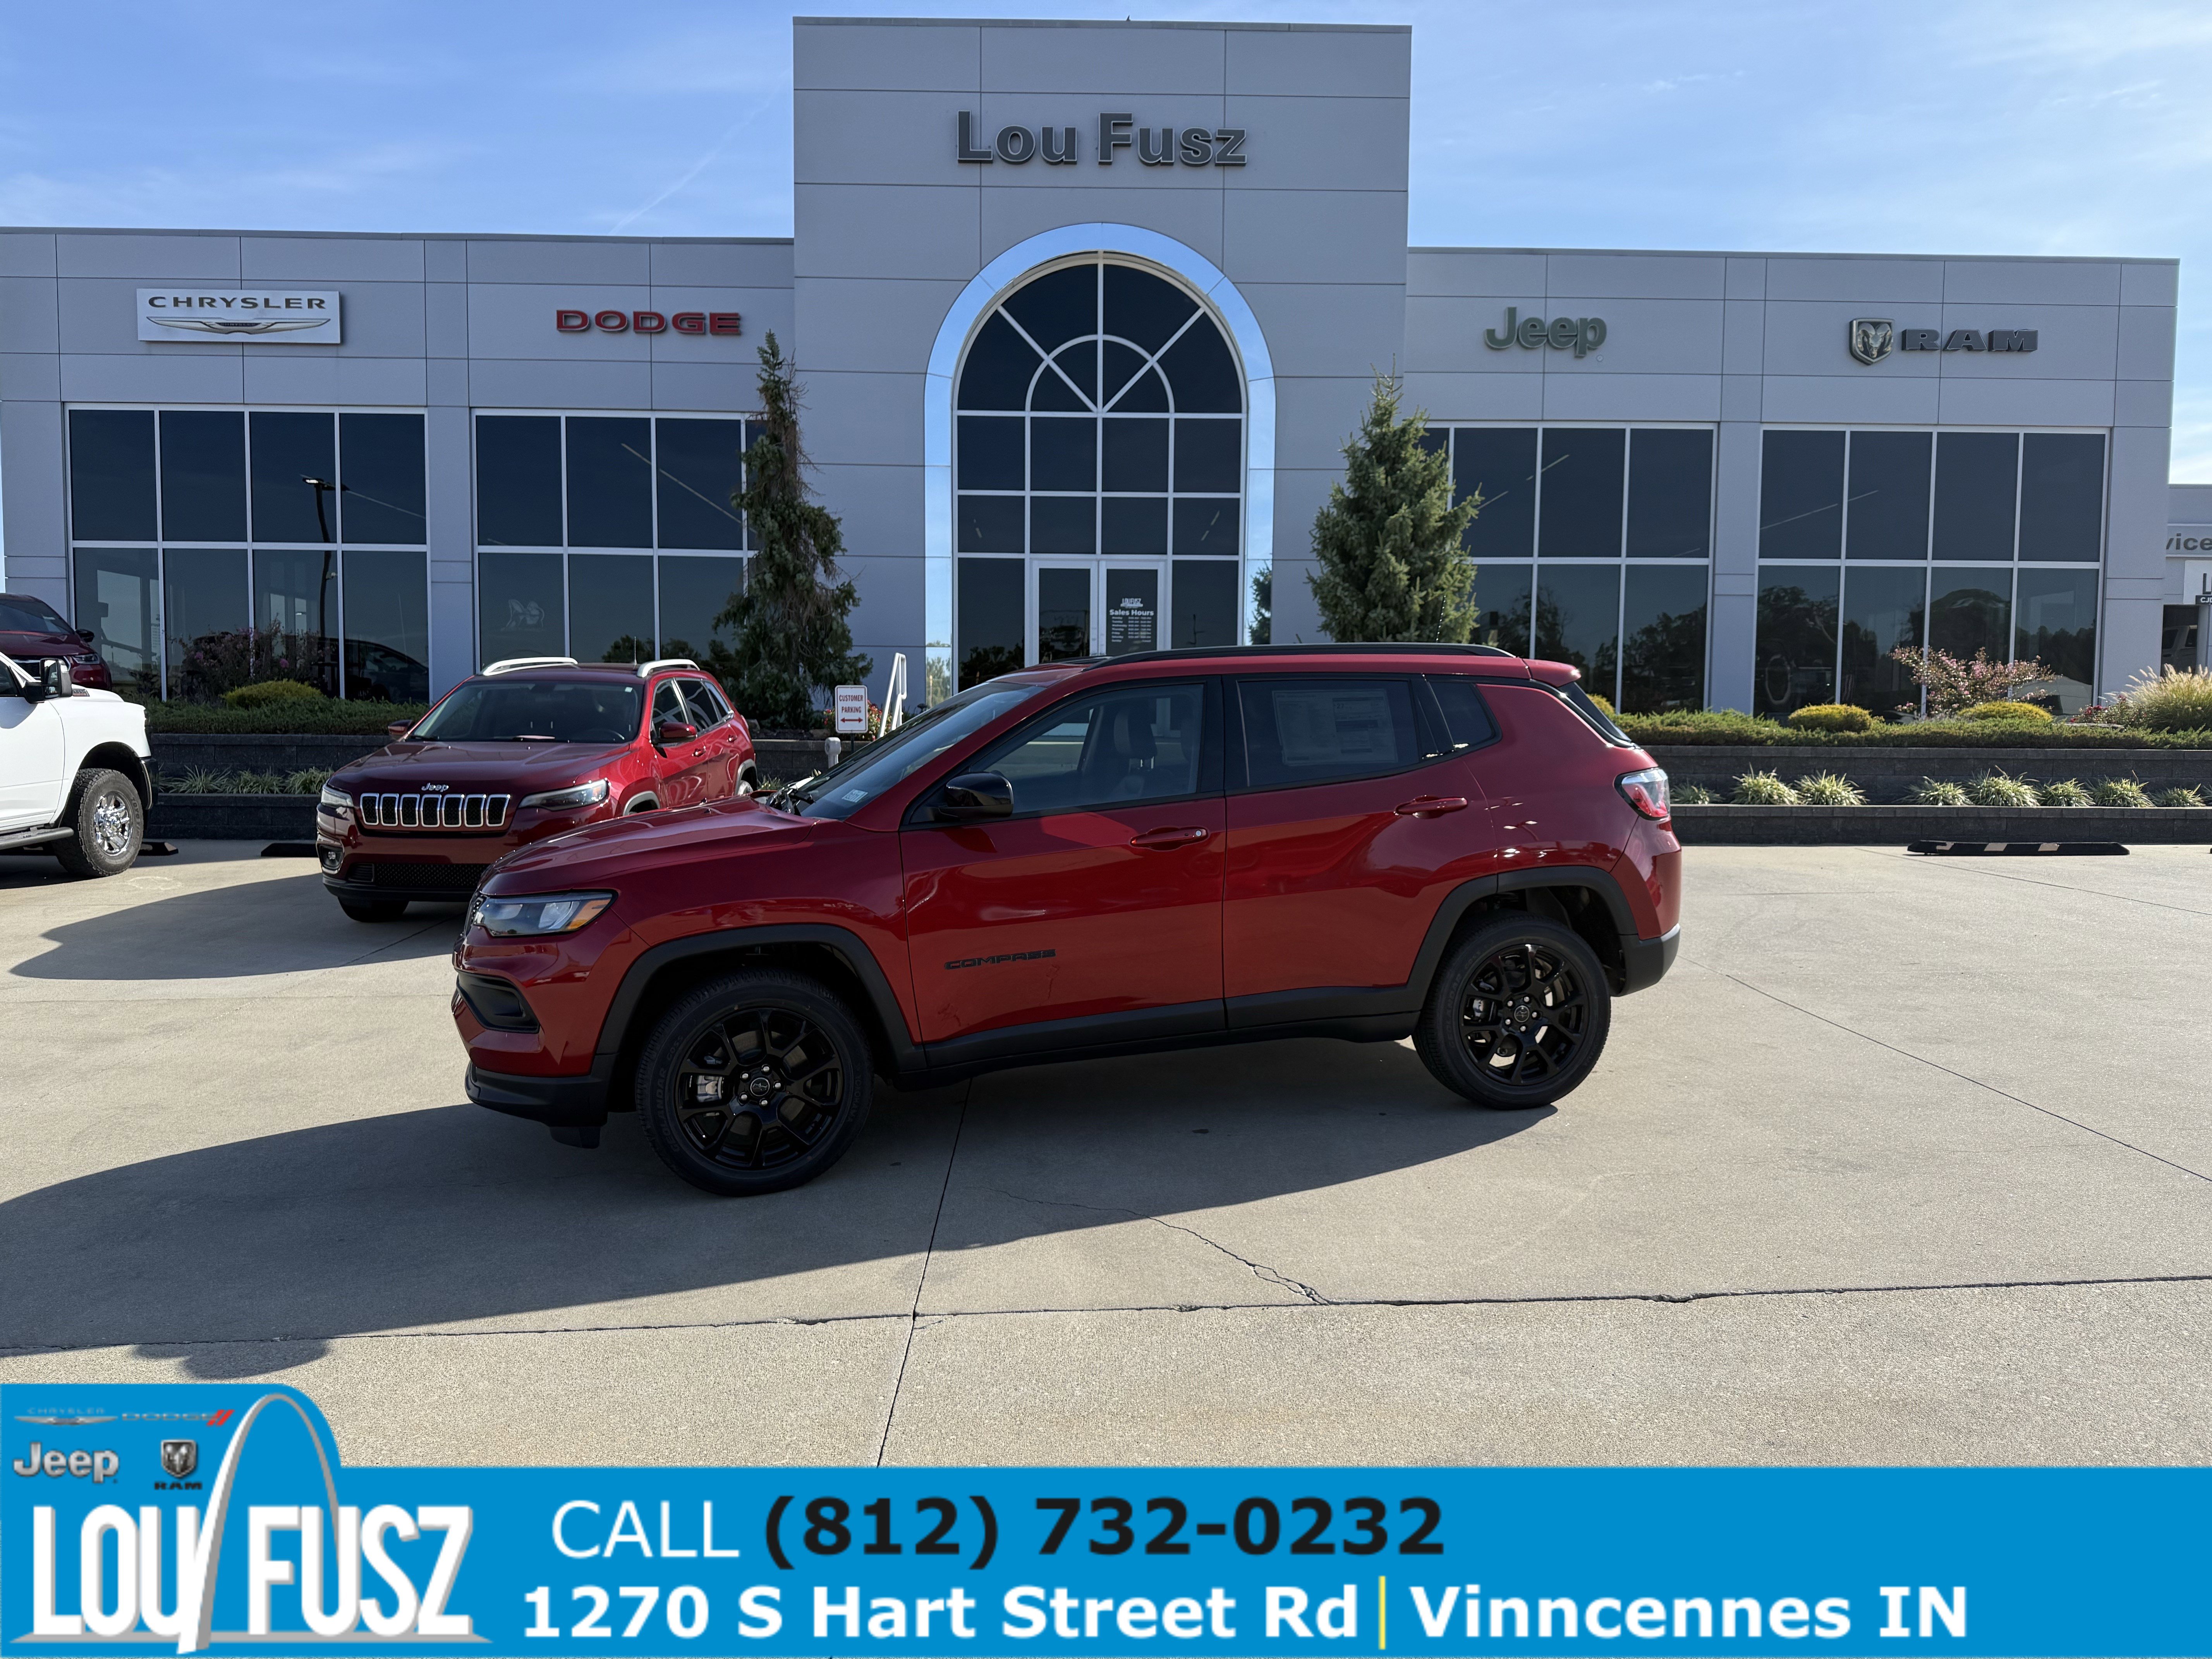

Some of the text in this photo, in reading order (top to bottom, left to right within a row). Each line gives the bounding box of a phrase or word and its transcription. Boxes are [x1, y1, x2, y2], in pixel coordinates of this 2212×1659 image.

[957, 110, 1247, 167] Lou Fusz
[148, 296, 326, 309] CHRYSLER
[556, 309, 742, 335] DODGE
[1484, 306, 1607, 358] Jeep
[1902, 329, 2039, 352] RAM
[421, 783, 449, 792] Jeep
[944, 949, 1056, 970] COMPASS
[655, 1067, 680, 1153] GEOLANDAR
